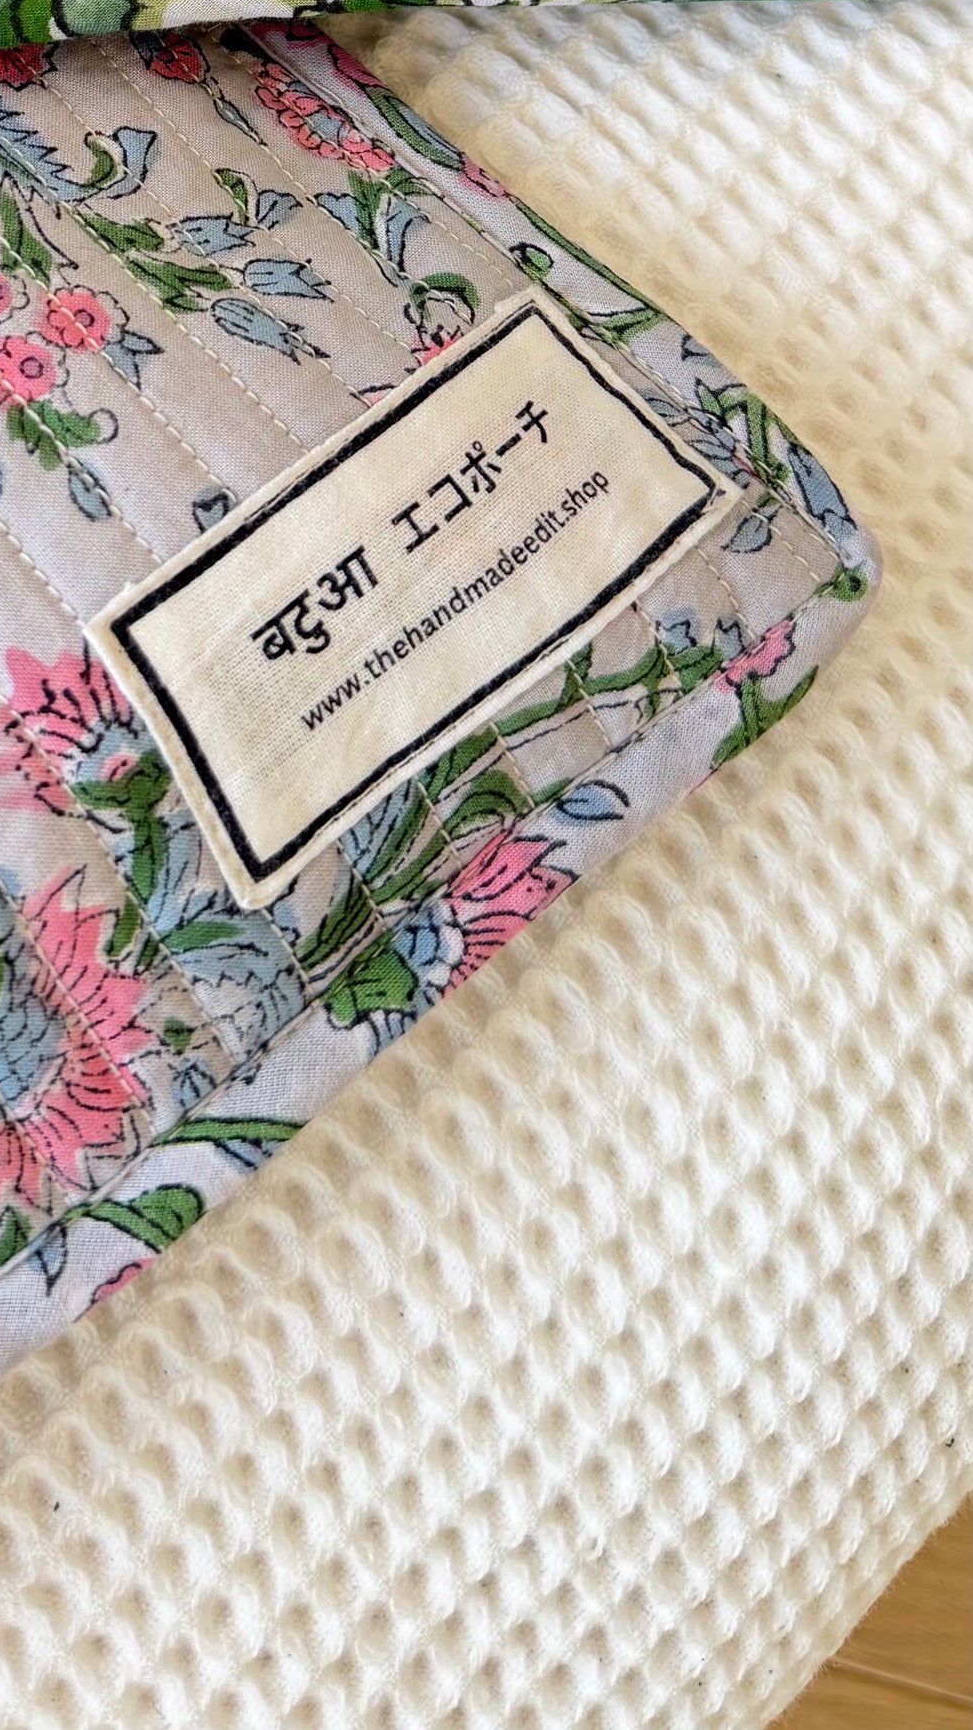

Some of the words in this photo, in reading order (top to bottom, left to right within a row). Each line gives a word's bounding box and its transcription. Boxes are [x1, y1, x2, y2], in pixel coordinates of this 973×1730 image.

[249, 545, 380, 665] बटुआ
[390, 400, 551, 554] エコポーチ
[300, 468, 610, 733] www.thehandmadeedit.shop
